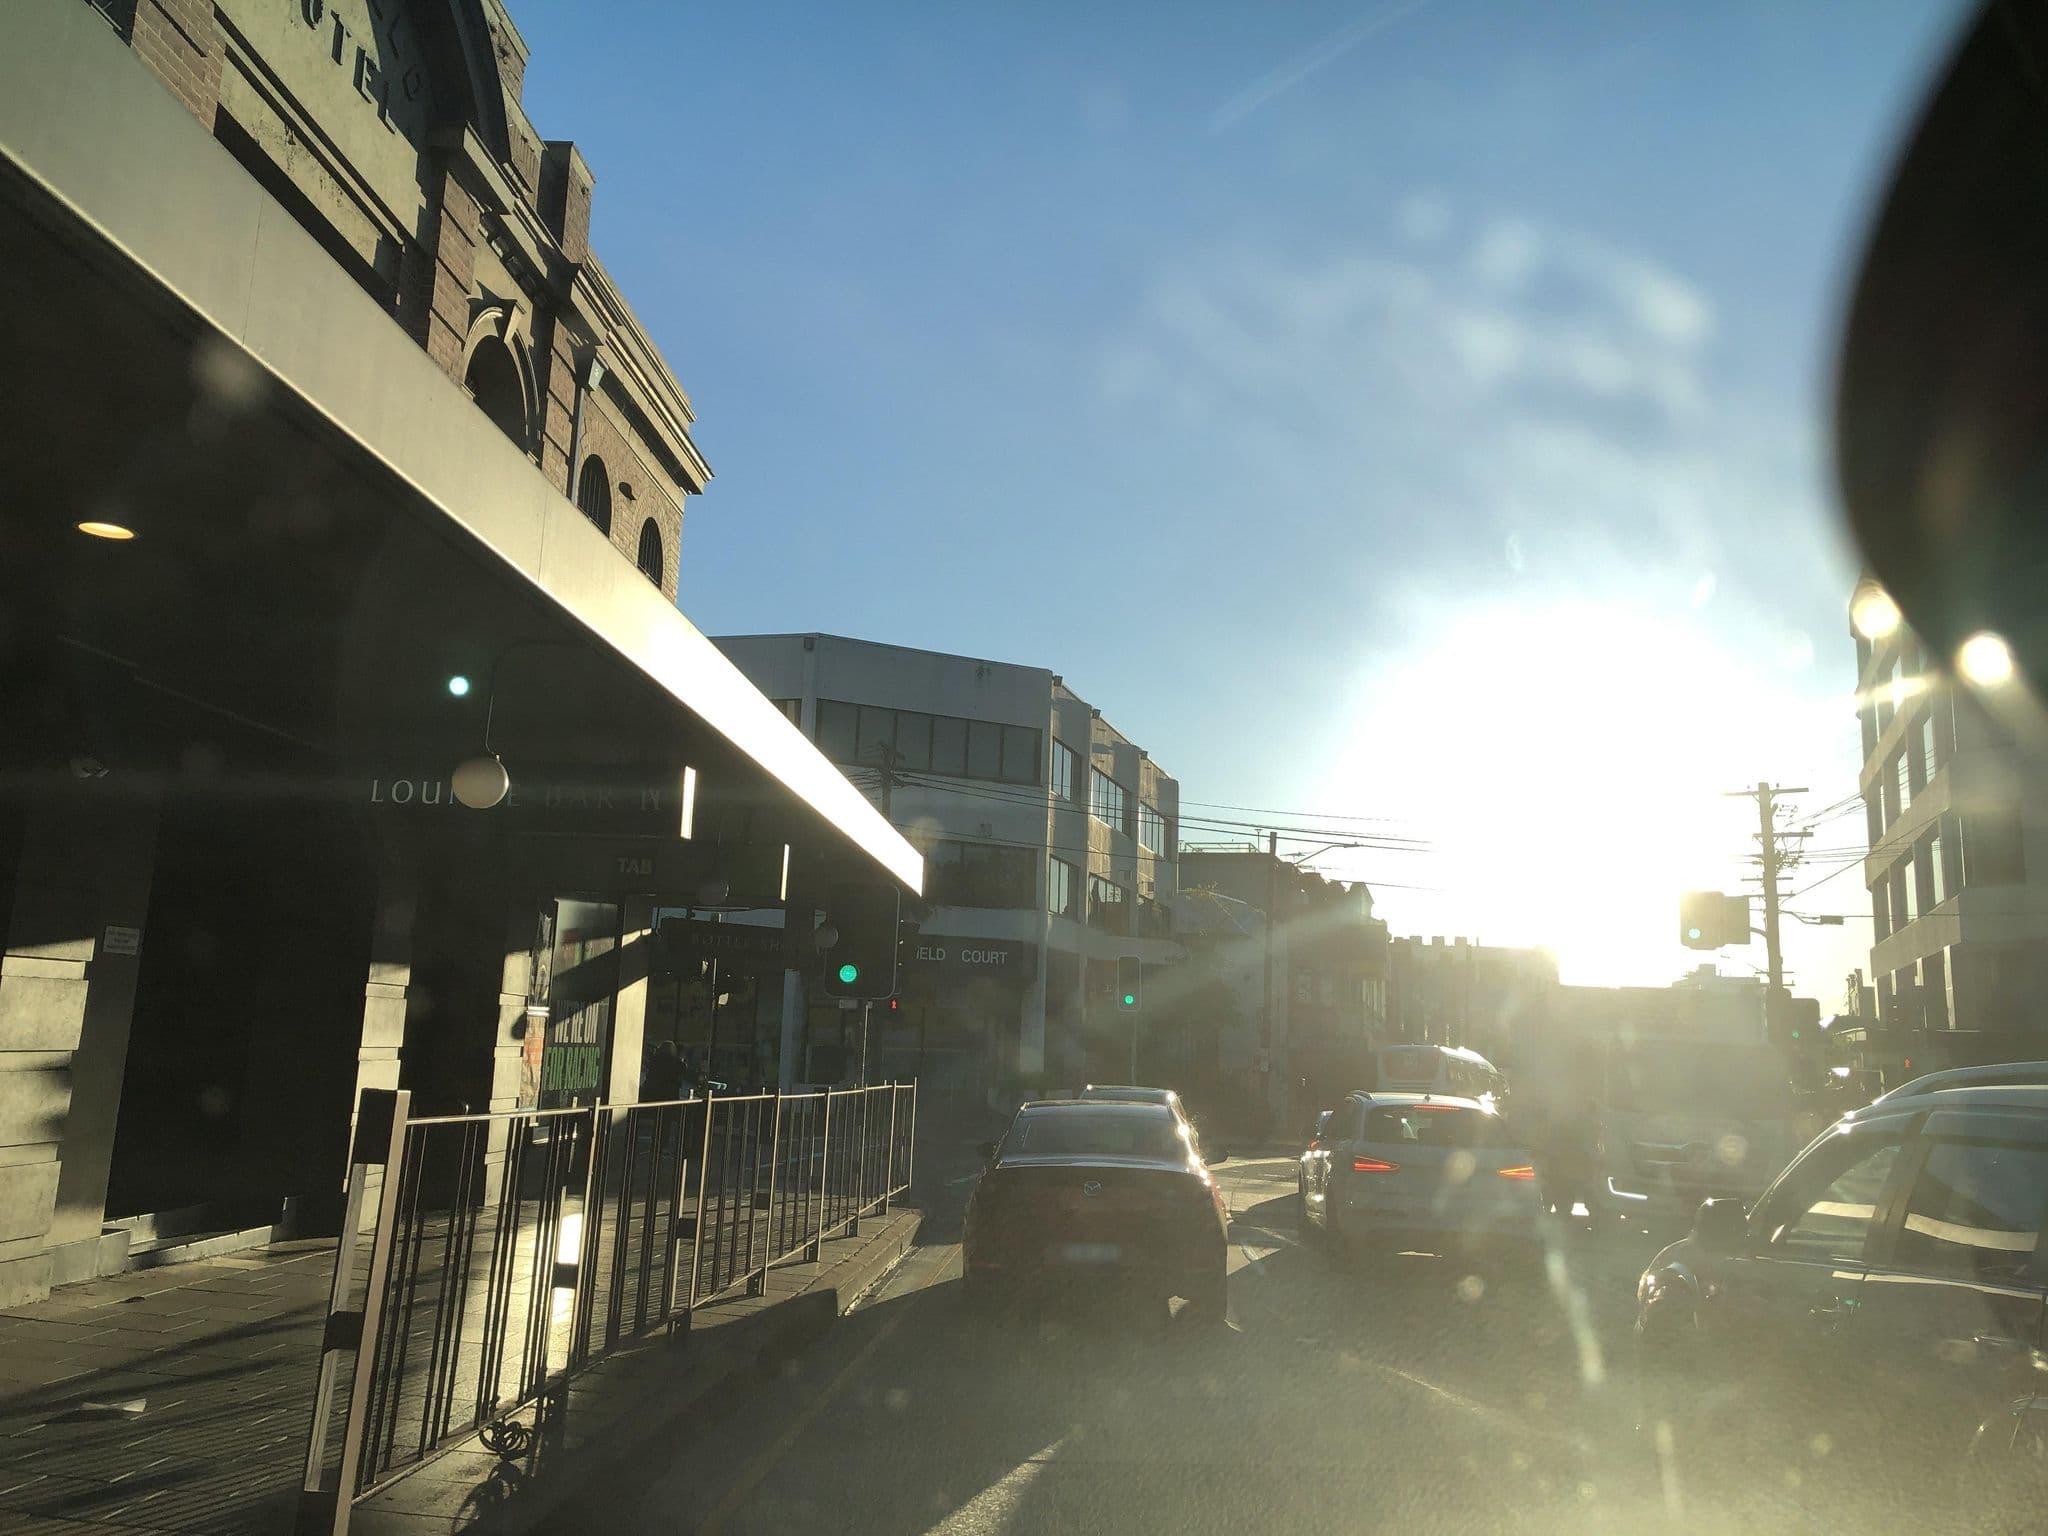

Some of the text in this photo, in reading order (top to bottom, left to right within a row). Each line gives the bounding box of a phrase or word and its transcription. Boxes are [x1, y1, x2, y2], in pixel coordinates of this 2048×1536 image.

[616, 857, 653, 875] TAB
[960, 949, 1008, 965] COURT
[543, 1046, 601, 1091] FOR RACING
